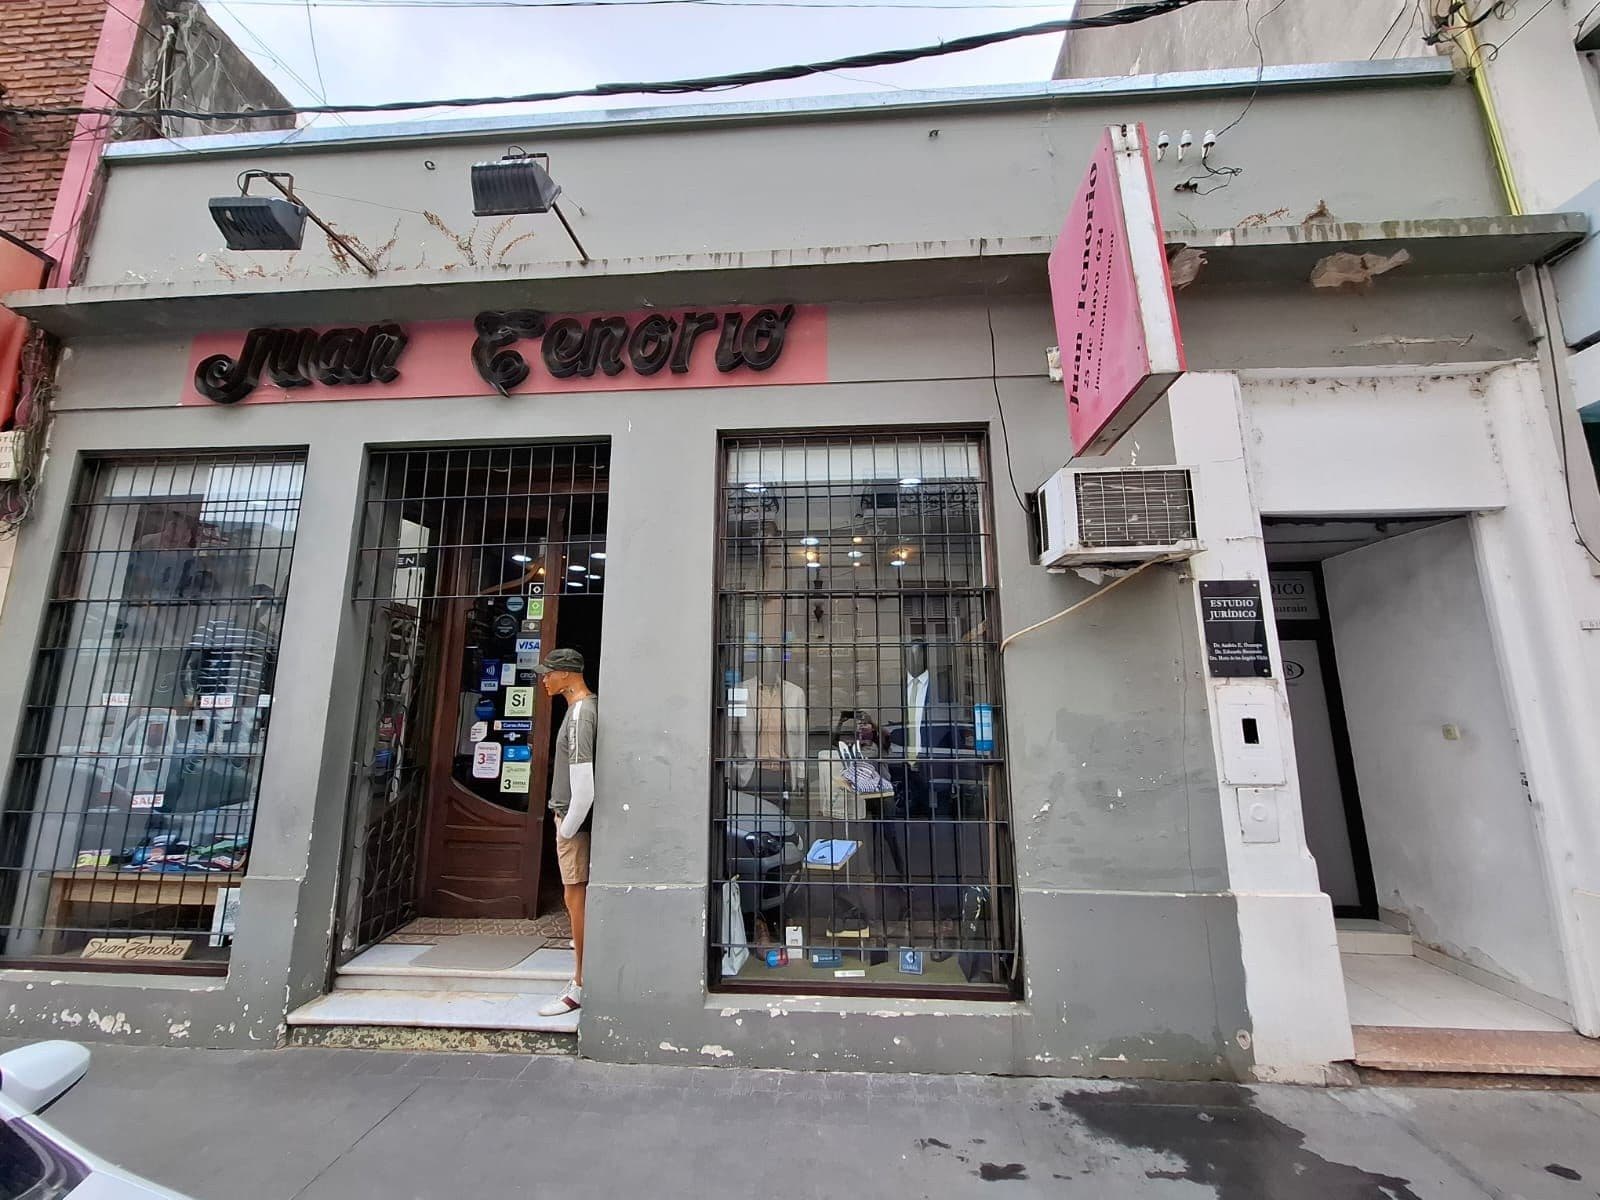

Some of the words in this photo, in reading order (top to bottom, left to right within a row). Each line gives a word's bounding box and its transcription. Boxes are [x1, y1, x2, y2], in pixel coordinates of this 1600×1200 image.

[1096, 227, 1104, 262] 624
[1069, 332, 1083, 413] Juan
[1076, 161, 1098, 318] Tenorio
[1089, 271, 1100, 328] Mayo
[193, 322, 408, 404] Juan
[470, 302, 795, 398] Tenorio
[1086, 337, 1093, 361] de
[1083, 369, 1090, 389] 25
[1210, 599, 1254, 607] ESTUDIO
[1209, 608, 1257, 620] JURÍDICO
[519, 641, 540, 650] VISA
[511, 692, 527, 707] Sí
[477, 752, 486, 765] 3
[503, 778, 512, 790] 3
[87, 940, 126, 958] Juan
[121, 941, 184, 959] Tenorio
